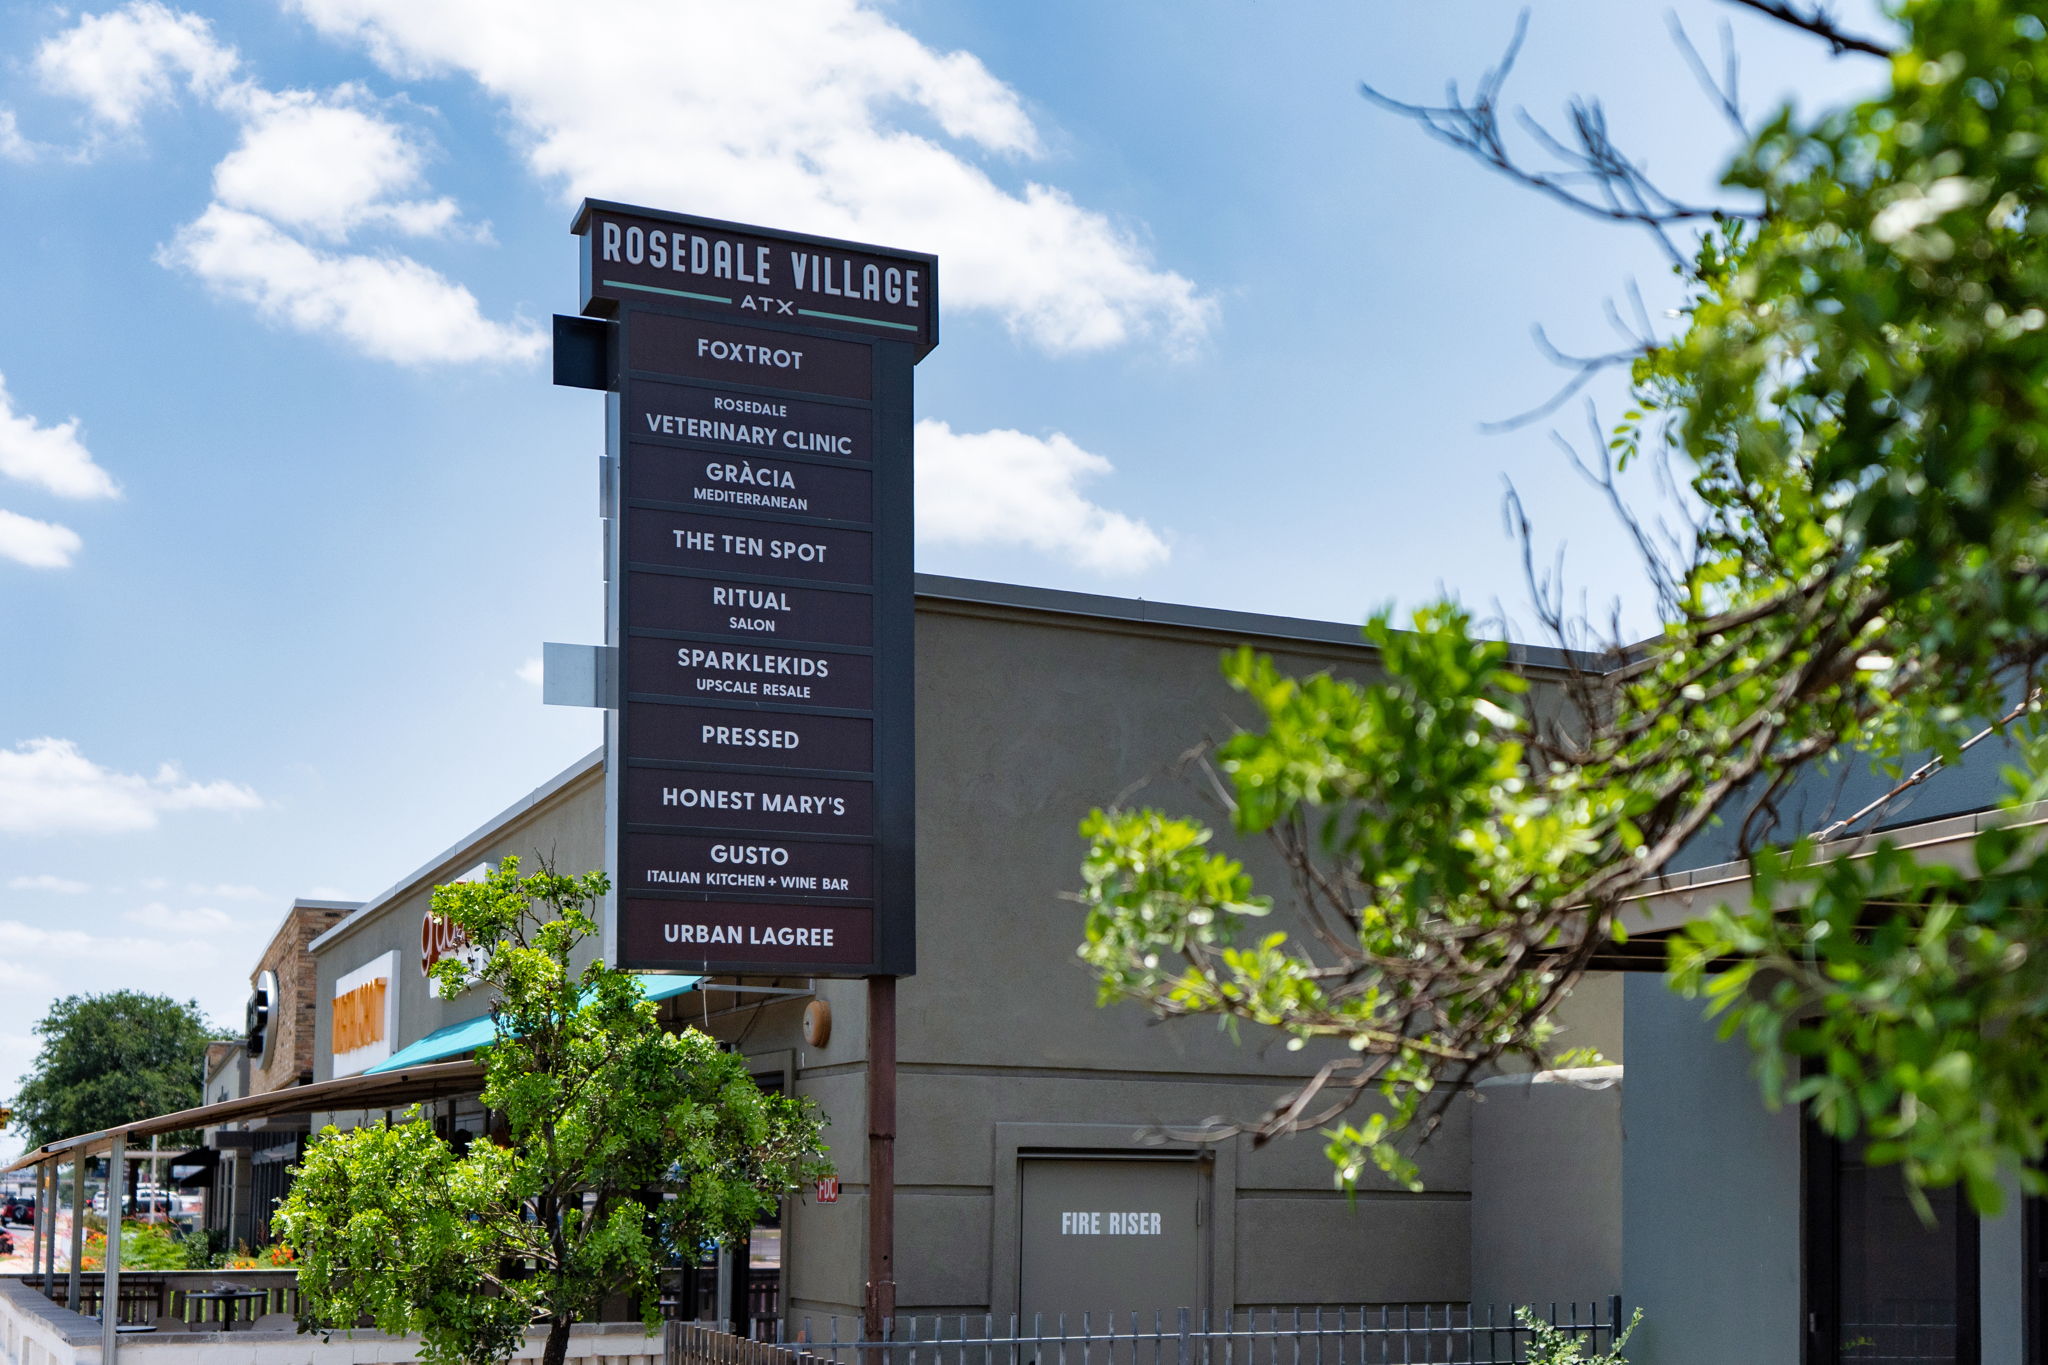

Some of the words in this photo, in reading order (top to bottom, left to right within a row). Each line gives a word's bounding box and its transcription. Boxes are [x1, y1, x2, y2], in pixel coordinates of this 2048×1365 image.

[603, 221, 770, 285] ROSEDALE
[790, 251, 919, 308] VILLAGE
[740, 294, 794, 316] ATX
[698, 338, 803, 370] FOXTROT
[714, 397, 787, 418] ROSEDALE
[645, 412, 778, 446] VETERINARY
[782, 430, 852, 455] CLINIC
[706, 460, 796, 490] GRÀCIA
[693, 487, 808, 511] MEDITERRANEAN
[672, 529, 715, 552] THE
[721, 534, 763, 557] TEN
[770, 540, 827, 563] SPOT
[713, 586, 791, 612] RITUAL
[729, 616, 775, 632] SALON
[677, 647, 829, 678] SPARKLEKIDS
[696, 678, 758, 695] UPSCALE
[762, 683, 811, 699] RESALE
[702, 725, 800, 749] PRESSED
[663, 787, 756, 811] HONEST
[762, 793, 845, 816] MARY'S
[710, 844, 789, 866] GUSTO
[647, 869, 701, 885] ITALIAN
[706, 872, 766, 887] KITCHEN
[779, 875, 817, 890] WINE
[822, 877, 849, 891] BAR
[664, 923, 743, 944] URBAN
[750, 926, 834, 947] LAGREE
[1061, 1211, 1101, 1235] FIRE
[1109, 1212, 1162, 1235] RISER
